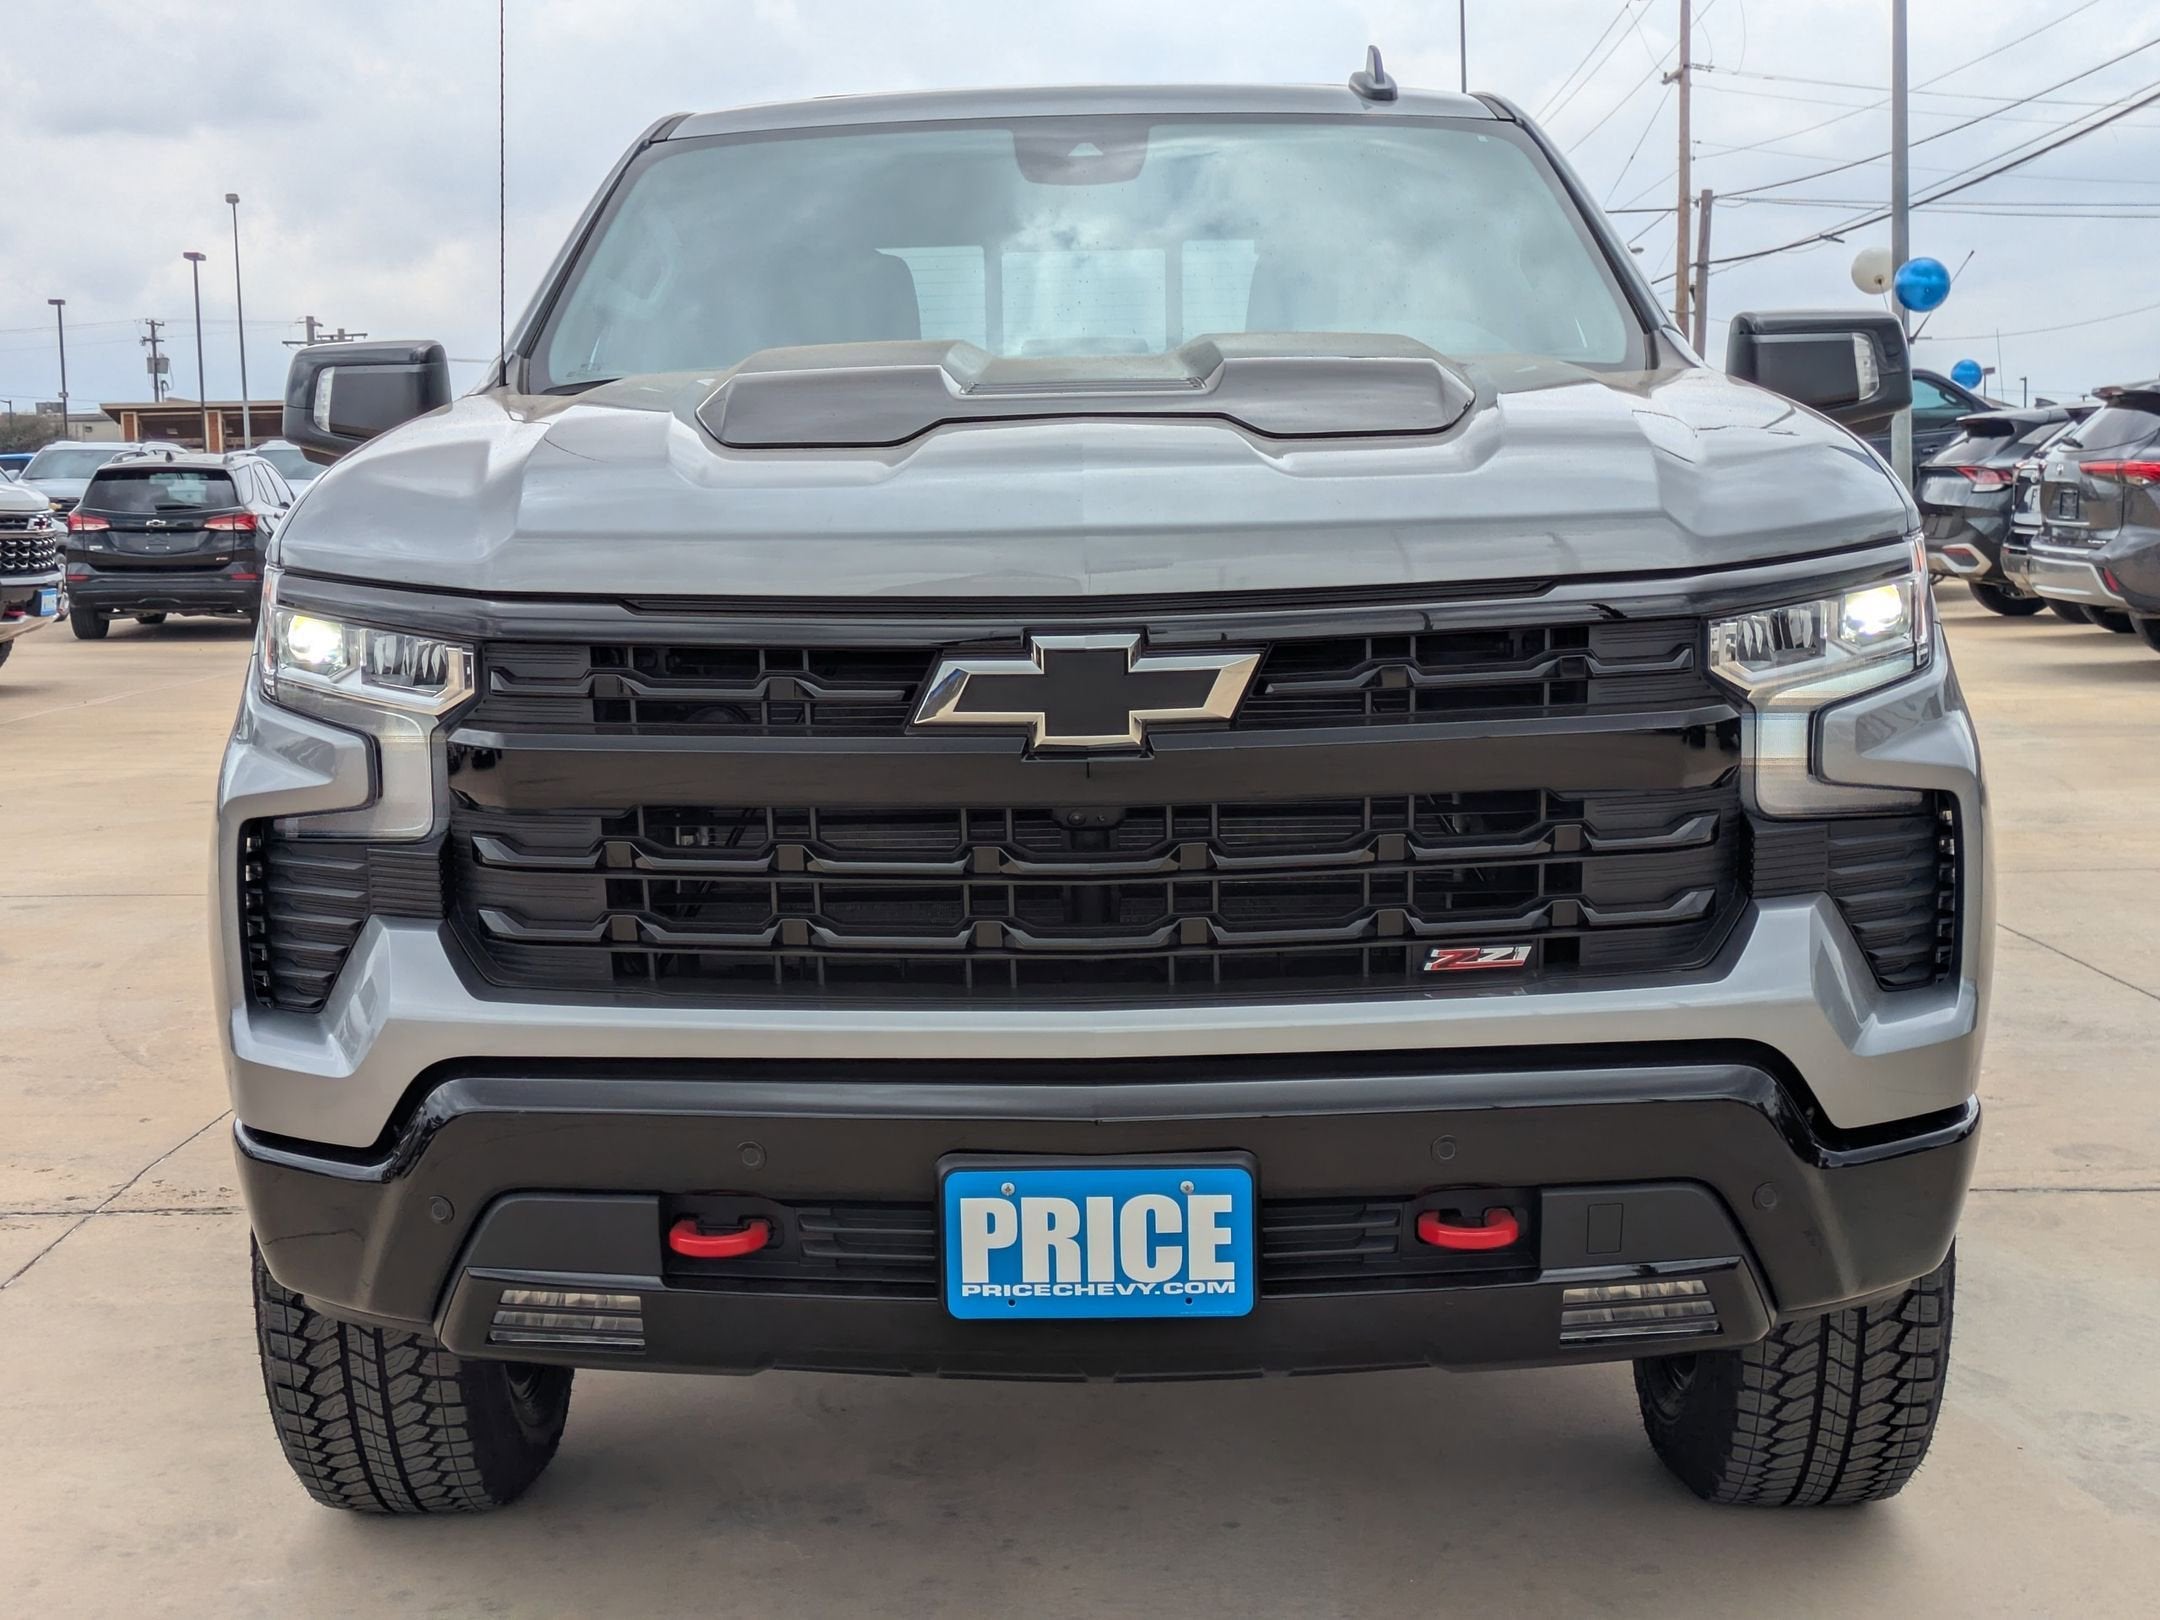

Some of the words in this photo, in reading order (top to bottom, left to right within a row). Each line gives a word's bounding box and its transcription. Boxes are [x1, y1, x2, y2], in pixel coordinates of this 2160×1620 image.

[1424, 946, 1532, 971] Z71
[960, 1194, 1235, 1284] PRICE
[961, 1281, 1235, 1297] PRICECHEVY.COM
